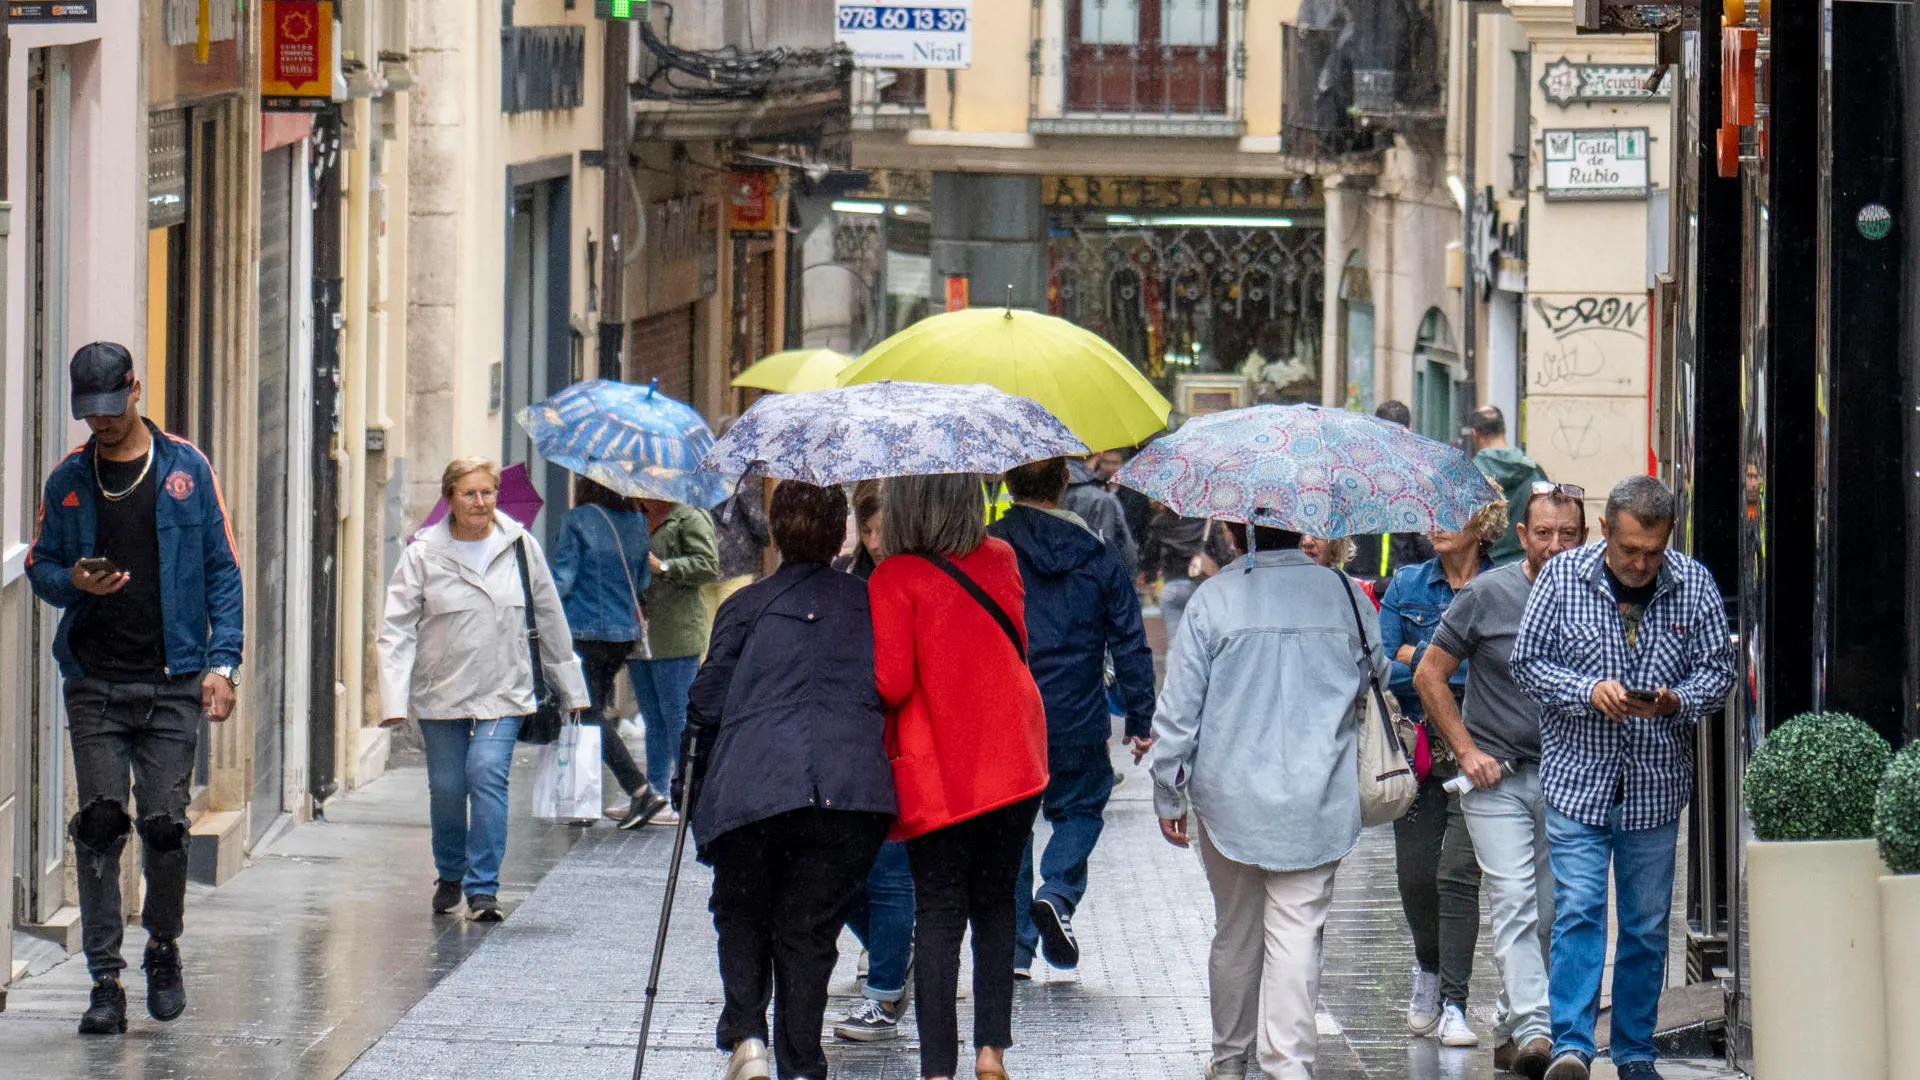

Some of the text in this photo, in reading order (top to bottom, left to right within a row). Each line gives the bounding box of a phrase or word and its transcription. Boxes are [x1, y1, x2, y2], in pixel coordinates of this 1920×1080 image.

[840, 8, 965, 31] 978 60 13 39
[1578, 141, 1616, 155] Calle
[1586, 156, 1605, 165] de
[1568, 167, 1620, 184] Rubio
